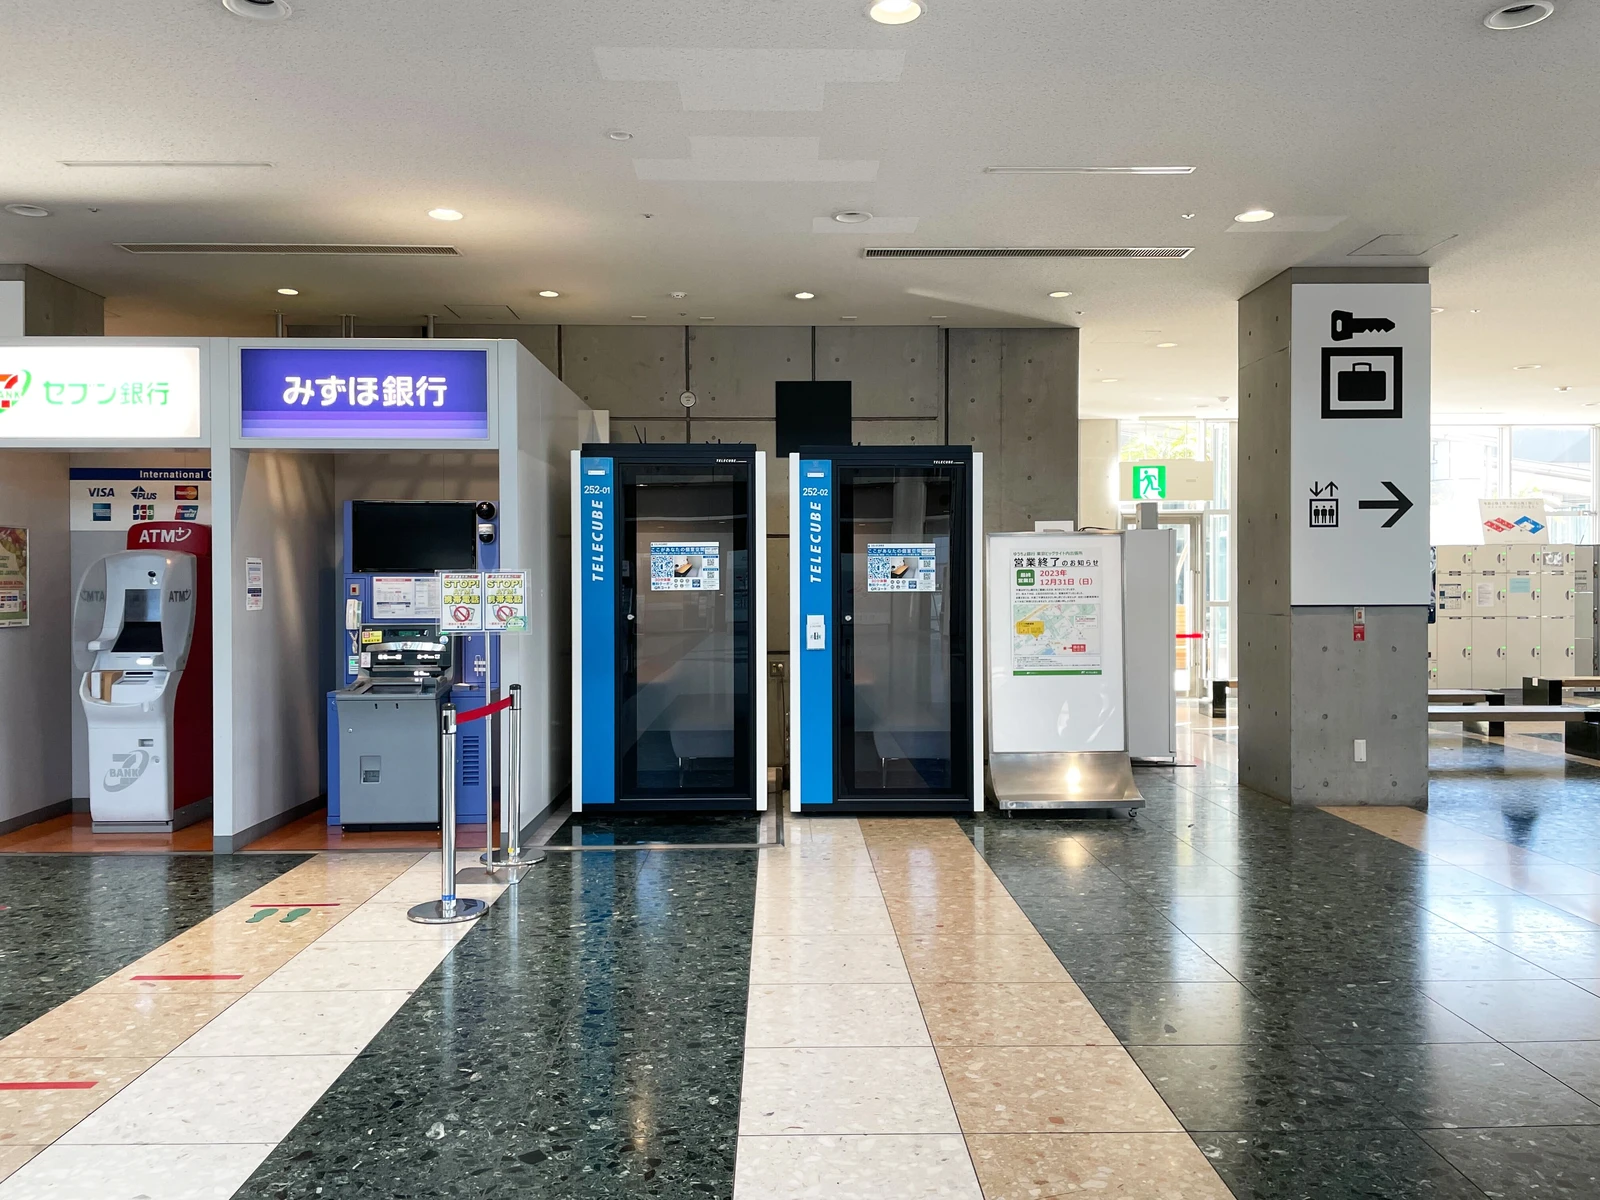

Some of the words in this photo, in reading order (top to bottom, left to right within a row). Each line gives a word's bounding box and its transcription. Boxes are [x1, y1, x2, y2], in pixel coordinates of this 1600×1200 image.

[43, 381, 169, 405] セブン銀行
[282, 375, 448, 407] みずほ銀行
[140, 470, 204, 479] International
[87, 487, 115, 497] VISA
[584, 485, 610, 494] 252-01
[802, 487, 828, 496] 252-02
[137, 492, 157, 500] PLUS
[592, 500, 603, 582] TELECUBE
[810, 501, 822, 583] TELECUBE
[1014, 557, 1099, 567] 営業終了のお知らせ
[1040, 569, 1067, 577] 2023年
[444, 580, 480, 588] STOP!
[487, 580, 522, 588] STOP!
[1040, 578, 1093, 586] 12月31日（日）
[109, 768, 138, 778] BANK
